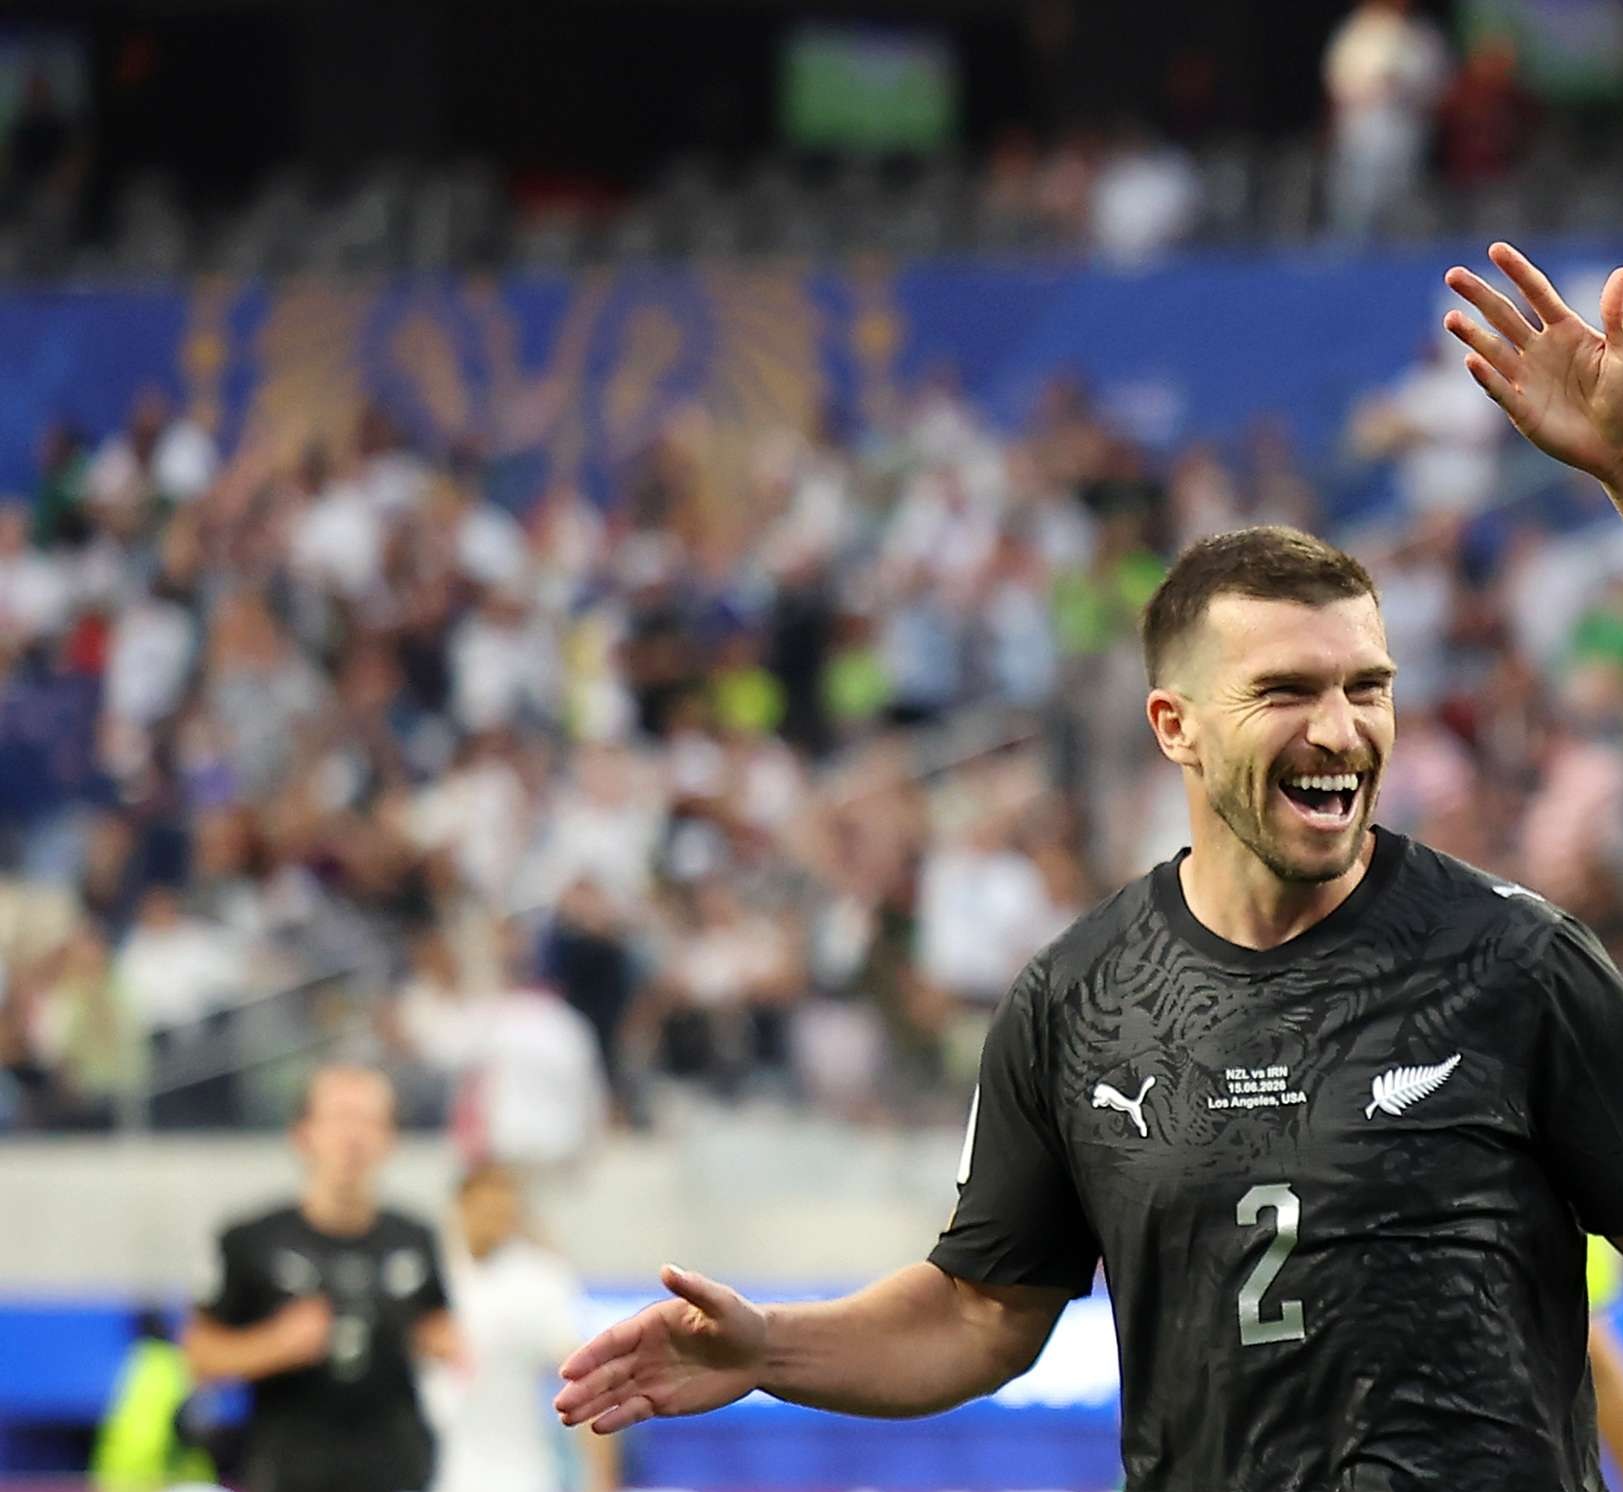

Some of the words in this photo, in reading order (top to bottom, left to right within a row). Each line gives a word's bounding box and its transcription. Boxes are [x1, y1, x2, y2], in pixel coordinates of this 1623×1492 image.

[1225, 1068, 1250, 1080] NZL
[1250, 1069, 1265, 1079] vs
[1266, 1065, 1288, 1078] IRN
[1207, 1097, 1229, 1109] Los
[1230, 1095, 1280, 1109] Angeles,
[1281, 1090, 1307, 1105] USA
[1236, 1182, 1306, 1346] 2
